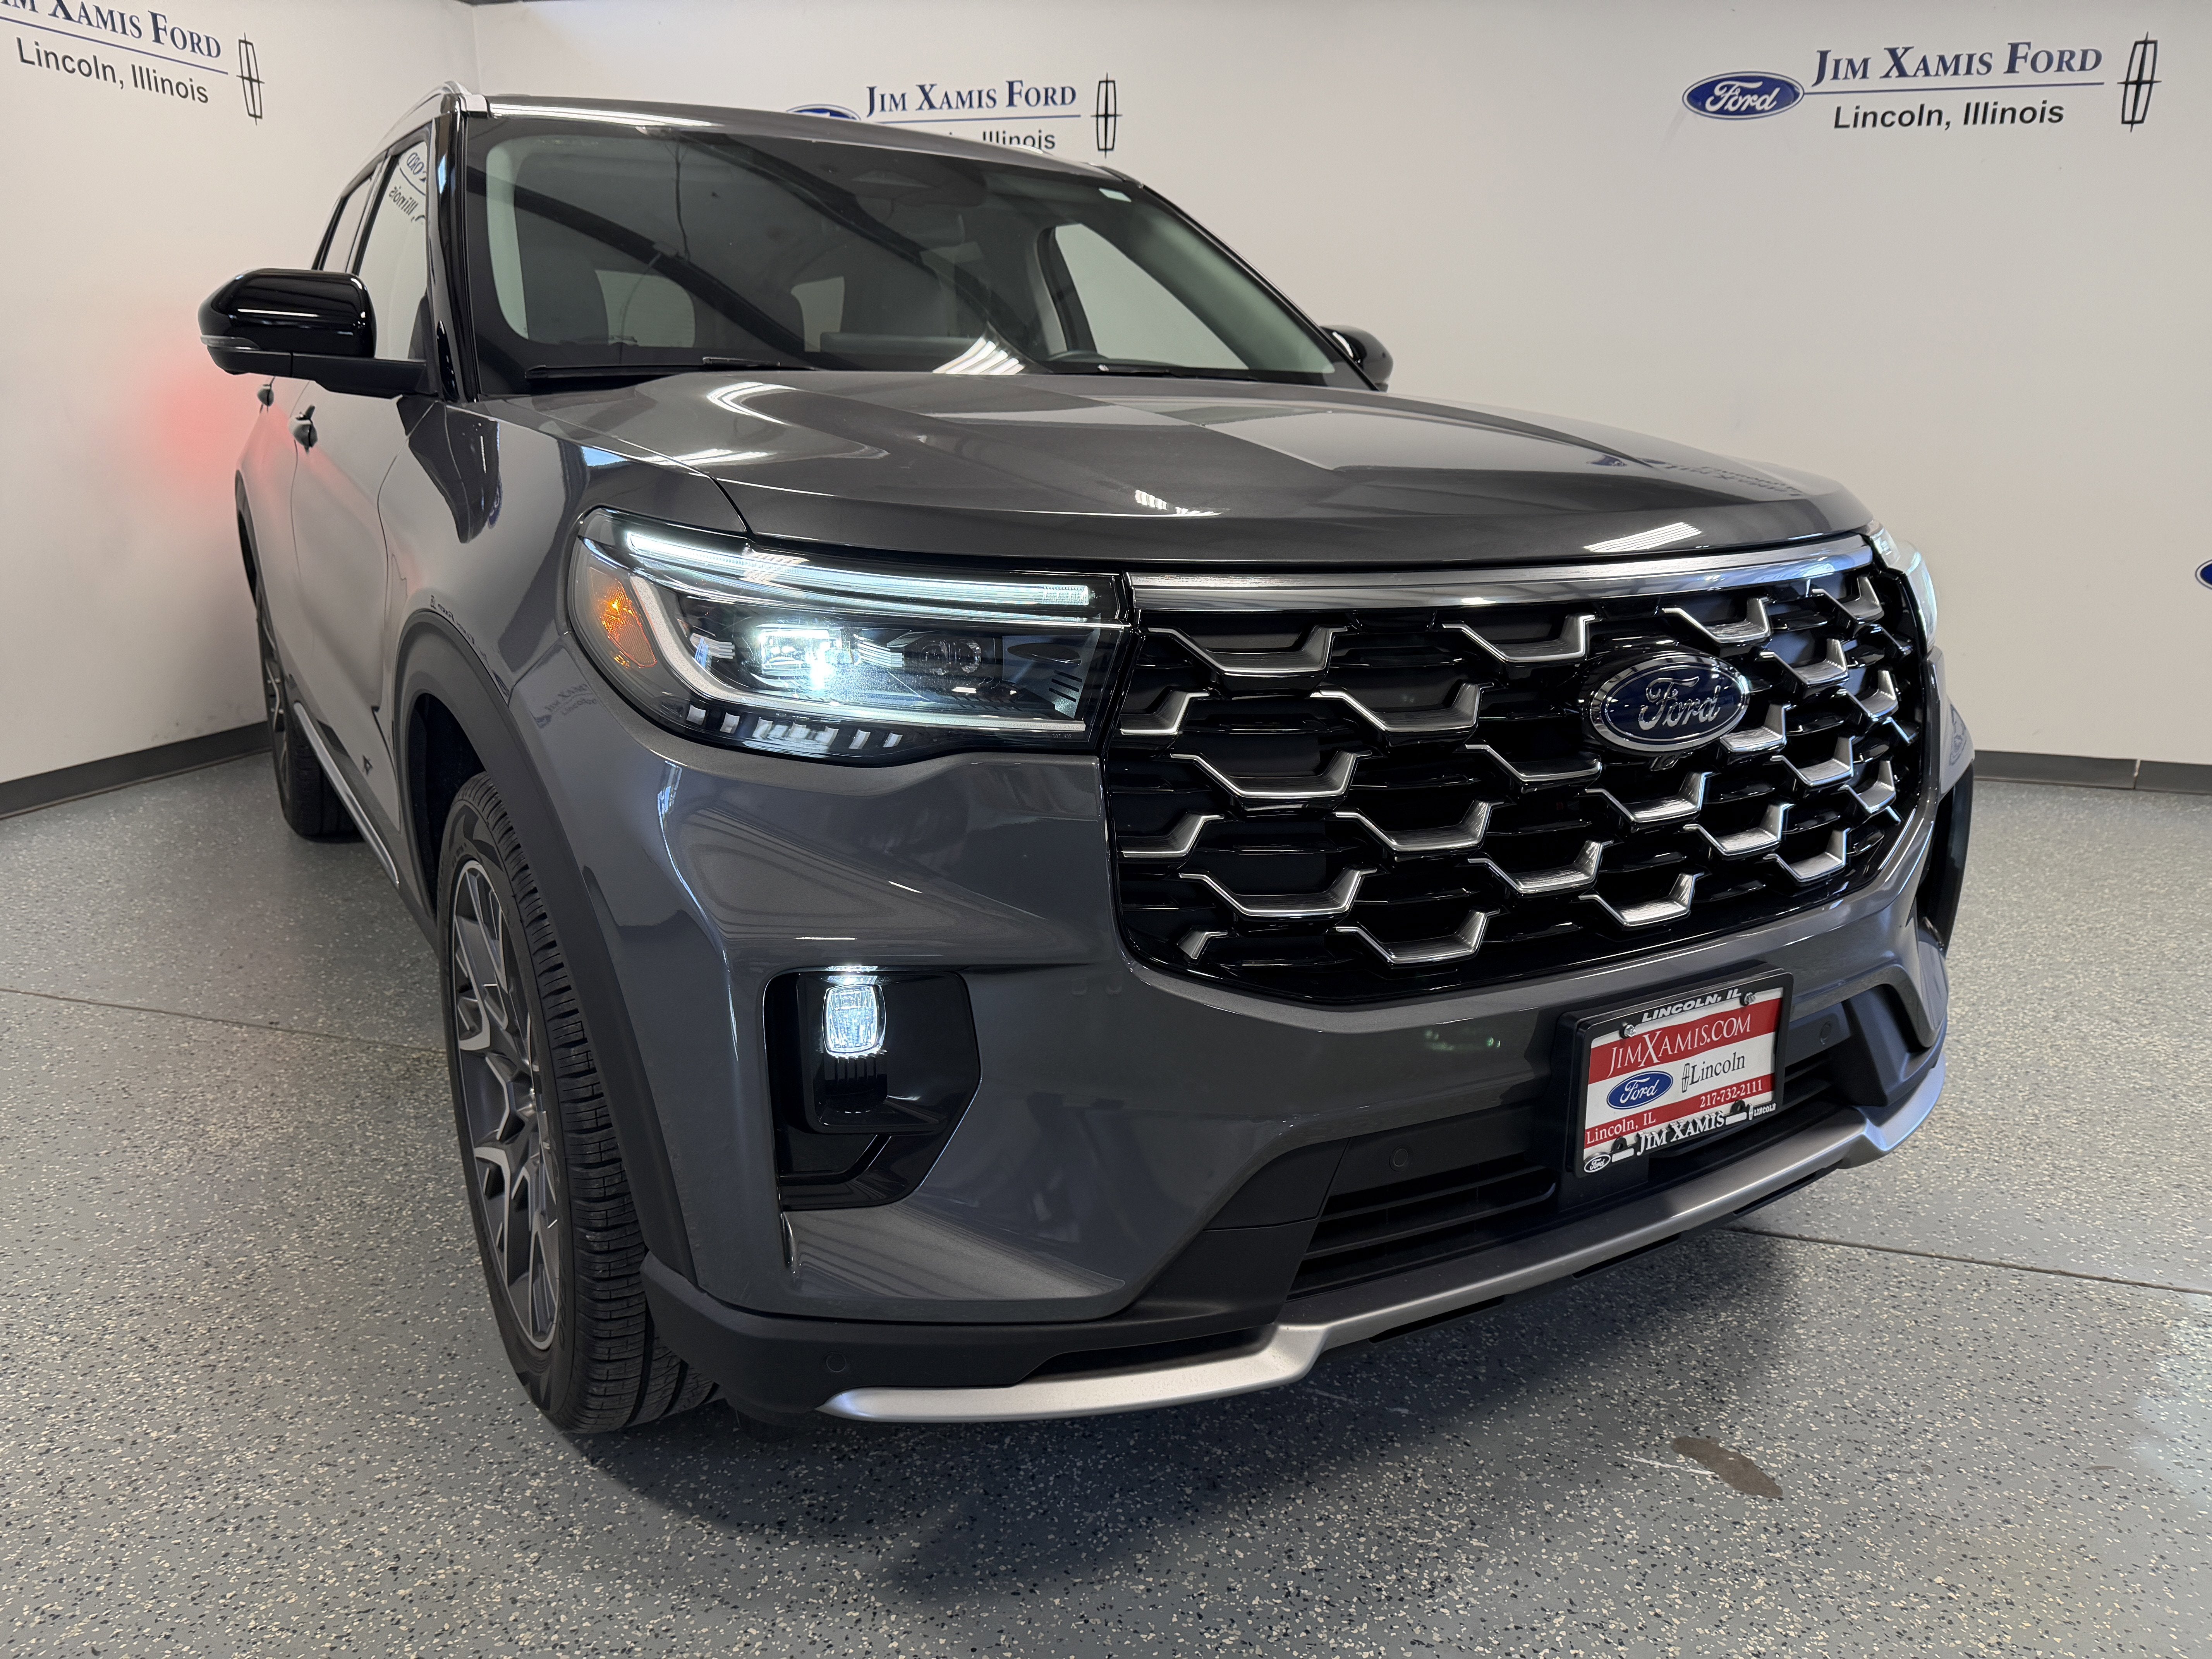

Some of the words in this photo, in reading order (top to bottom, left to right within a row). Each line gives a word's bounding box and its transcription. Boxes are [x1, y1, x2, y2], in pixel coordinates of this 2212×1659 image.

[148, 10, 221, 58] FORD
[16, 37, 124, 90] Lincoln,
[131, 64, 208, 103] Illinois
[1811, 50, 1871, 87] JIM
[1880, 46, 1993, 79] XAMIS
[2003, 42, 2102, 74] FORD
[866, 86, 908, 117] JIM
[915, 83, 997, 112] XAMIS
[1006, 80, 1077, 107] FORD
[1705, 80, 1779, 112] Ford
[1834, 103, 1952, 131] Lincoln,
[1963, 100, 2064, 127] Illinois
[1638, 676, 1721, 731] Ford
[1642, 994, 1722, 1022] LINCOLN,
[1726, 988, 1741, 1000] IL
[1607, 1013, 1751, 1078] JIMXAMIS.COM
[1689, 1051, 1745, 1086] Lincoln
[1620, 1077, 1658, 1104] Ford
[1700, 1080, 1763, 1108] 217-732-2111
[1587, 1118, 1638, 1145] Lincoln,
[1643, 1113, 1656, 1126] IL
[1637, 1132, 1668, 1156] JIM
[1669, 1113, 1725, 1142] XAMIS
[1589, 1157, 1605, 1169] Ford
